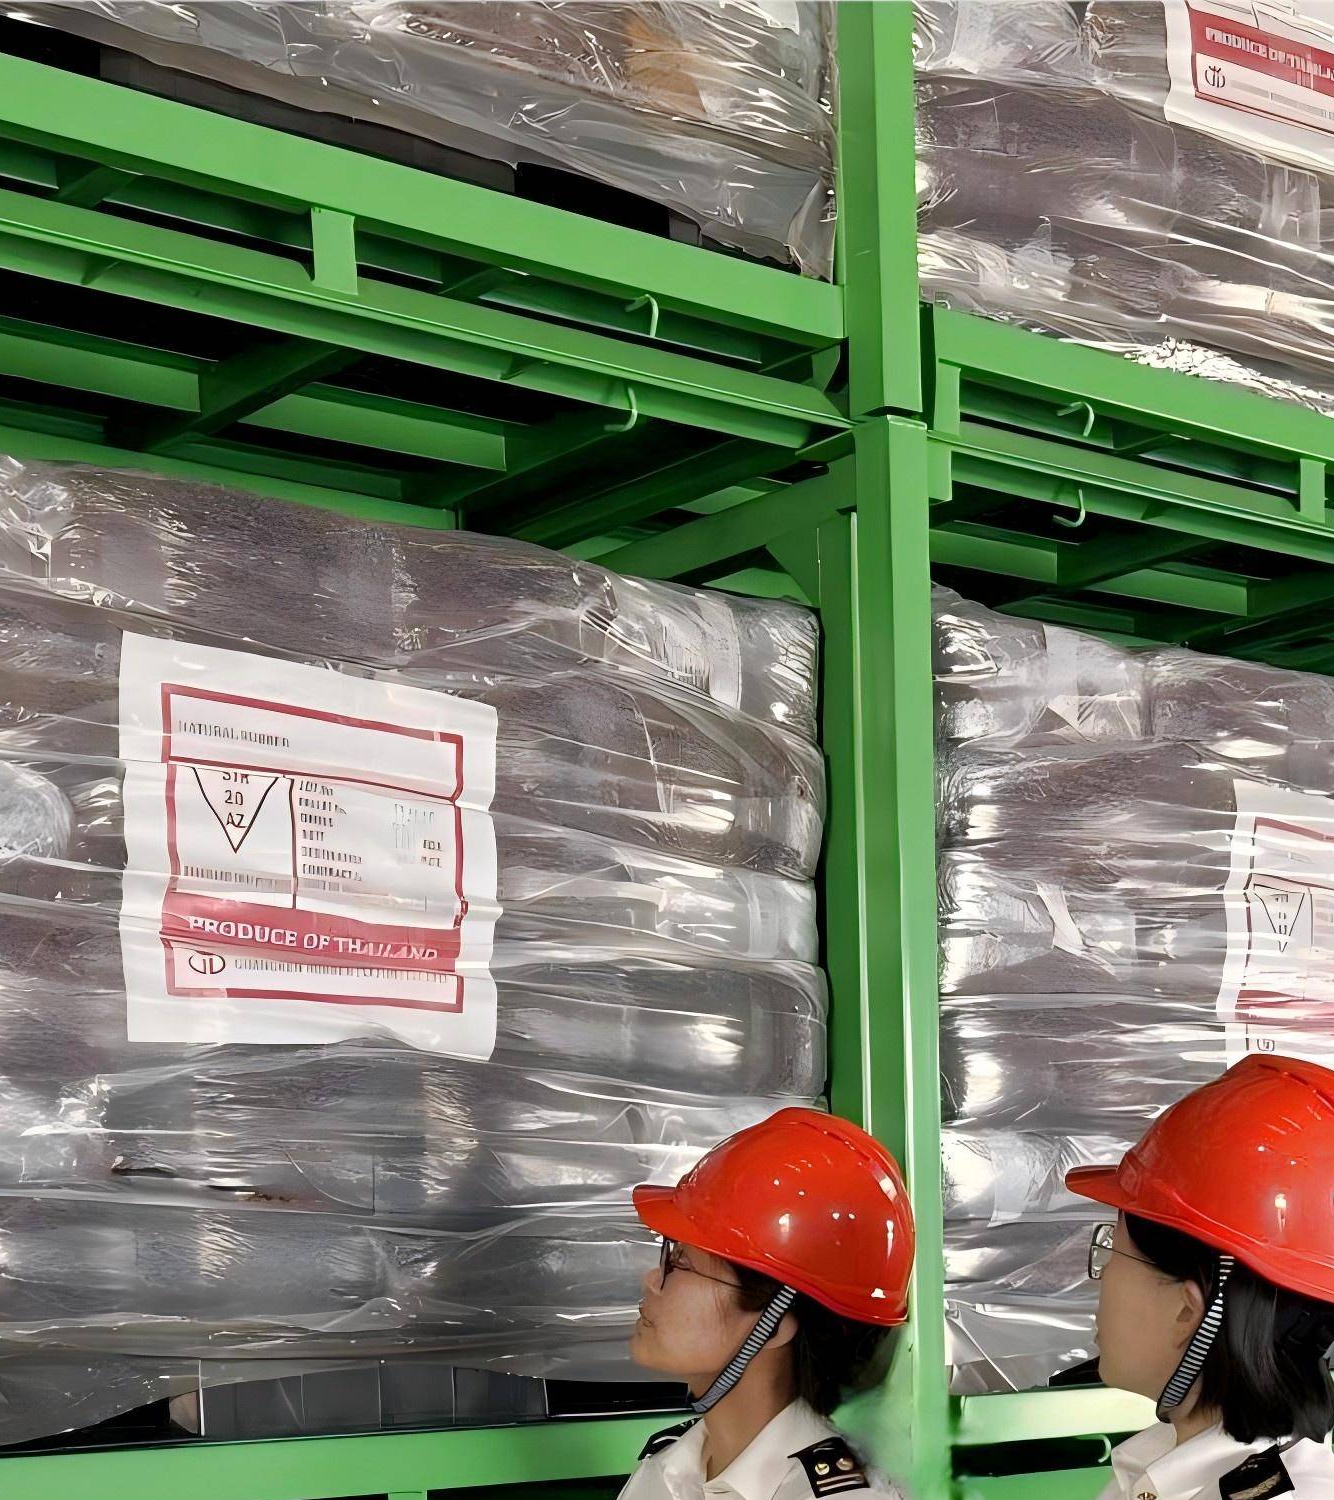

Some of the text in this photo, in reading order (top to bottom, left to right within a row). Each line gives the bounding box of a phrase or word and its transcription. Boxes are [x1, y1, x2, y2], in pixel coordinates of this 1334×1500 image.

[187, 915, 439, 961] PRODUCE OF THAILAND
